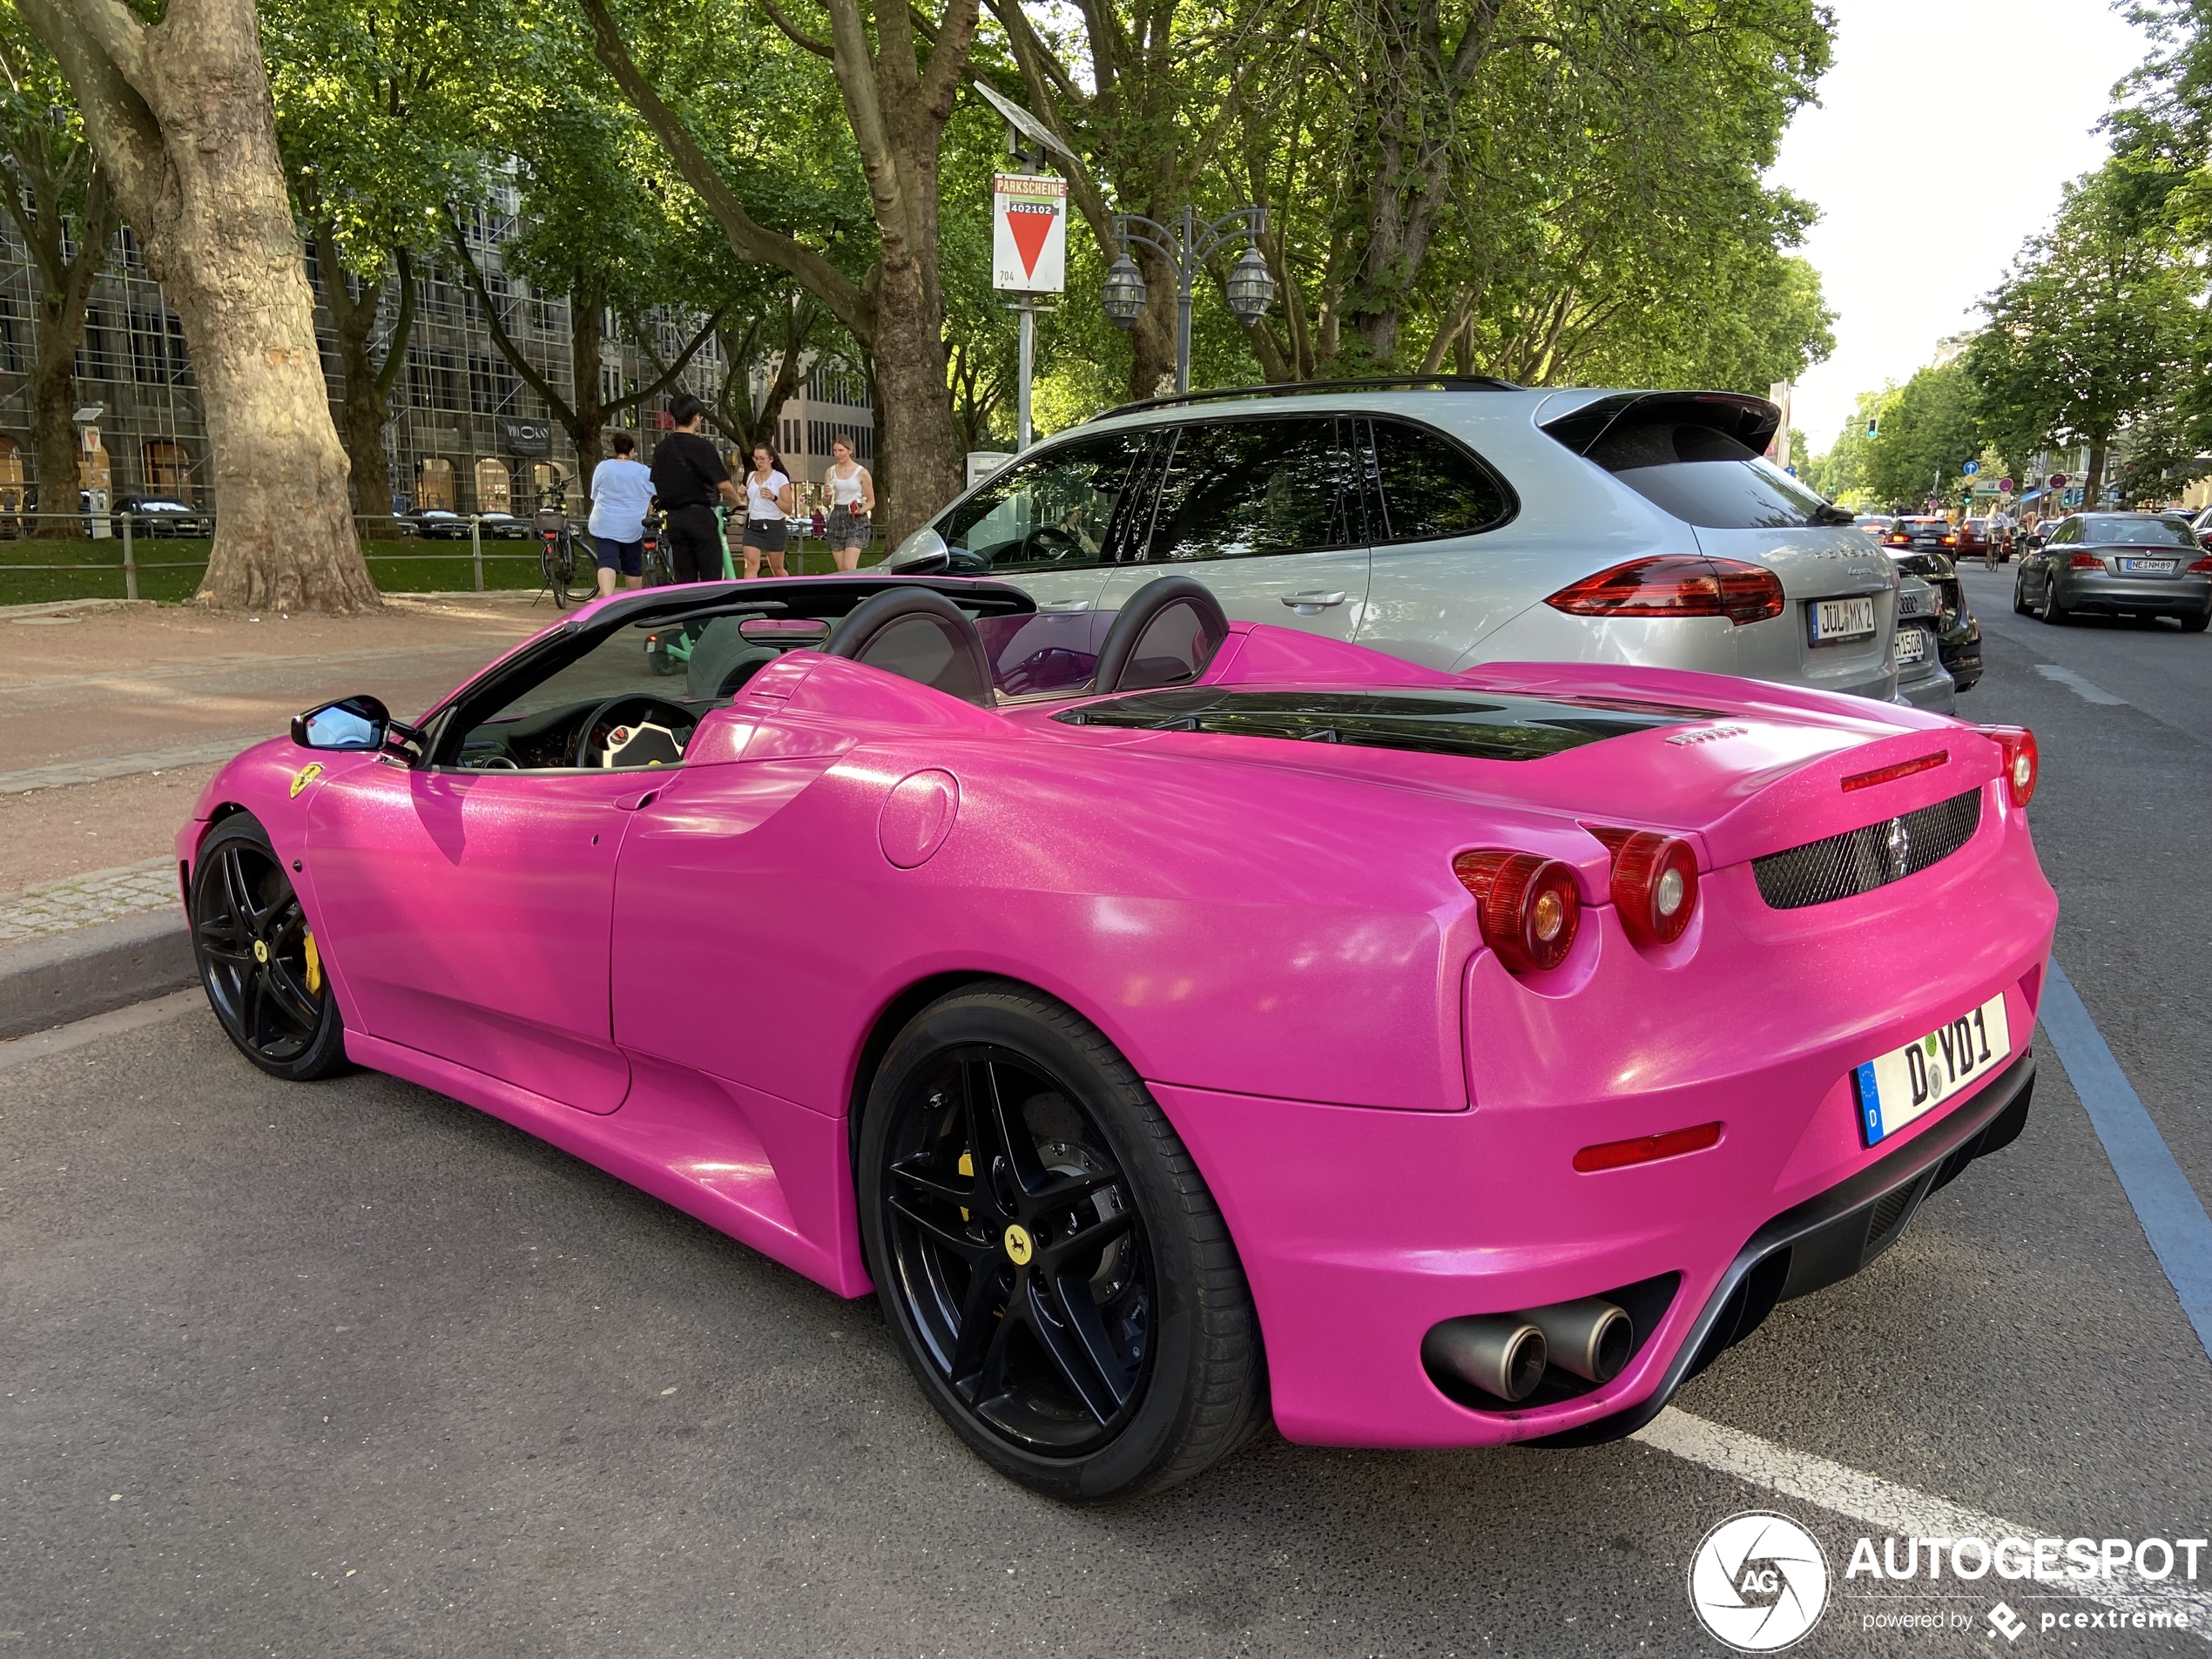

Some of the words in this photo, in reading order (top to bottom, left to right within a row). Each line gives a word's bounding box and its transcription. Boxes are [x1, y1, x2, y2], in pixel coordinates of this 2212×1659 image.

[997, 179, 1064, 196] PARKSCHEINE
[1011, 204, 1051, 214] 402102
[1000, 270, 1014, 281] 704
[1850, 602, 1864, 631] MX
[1865, 602, 1872, 629] 2
[1869, 1109, 1878, 1128] D
[1905, 1042, 1928, 1108] D
